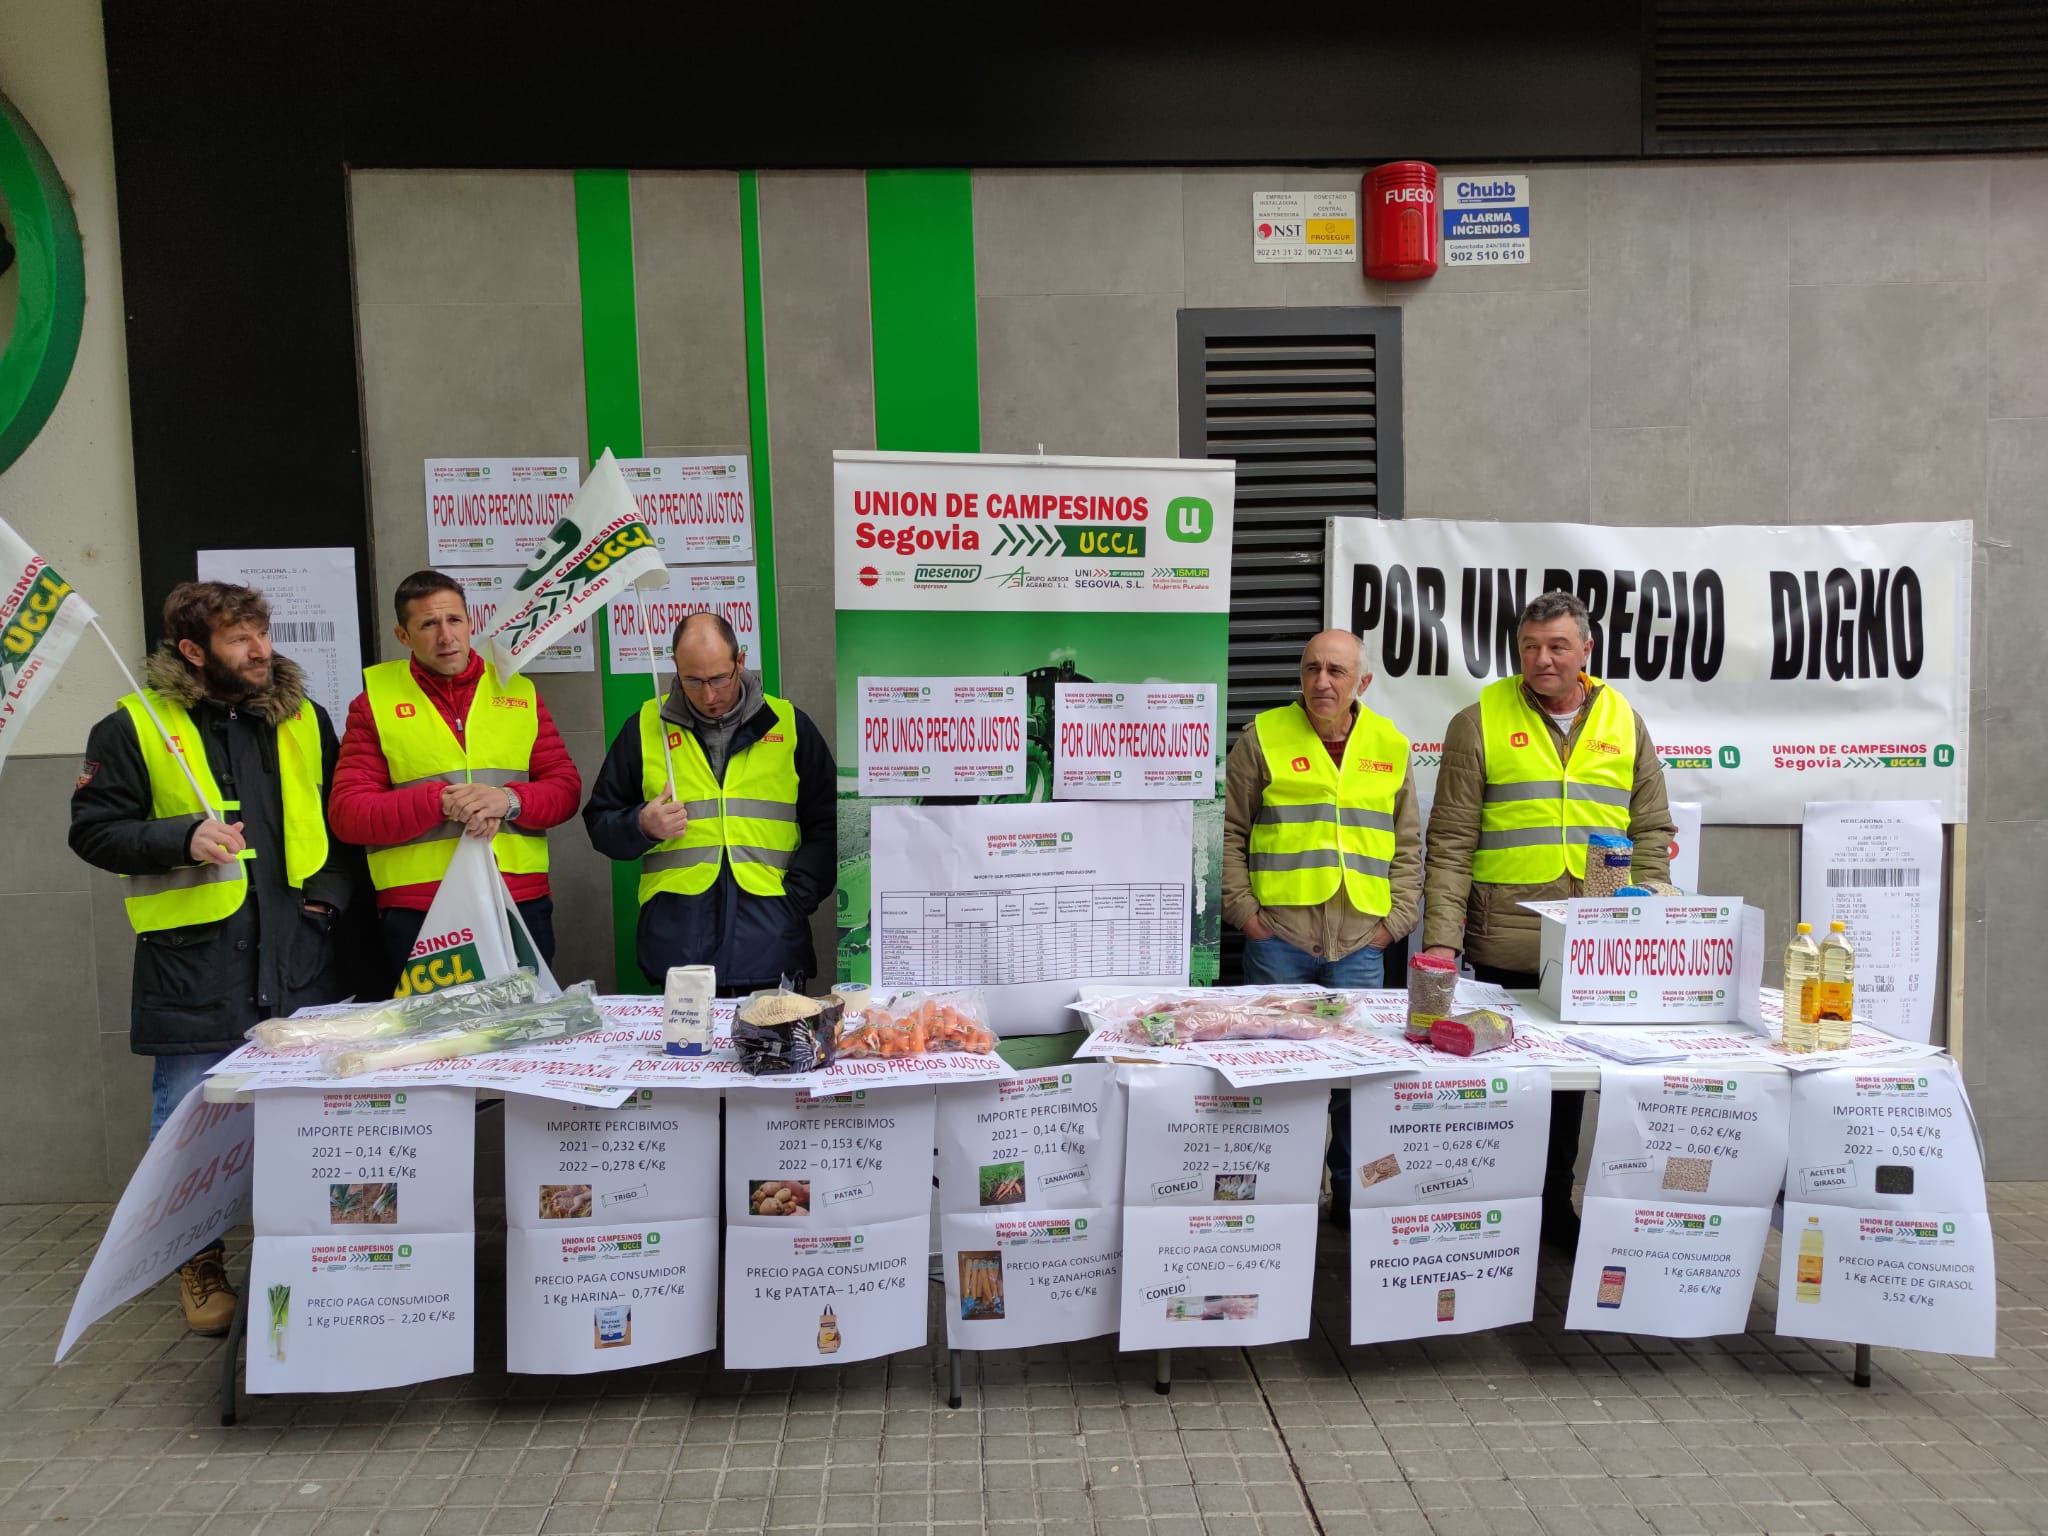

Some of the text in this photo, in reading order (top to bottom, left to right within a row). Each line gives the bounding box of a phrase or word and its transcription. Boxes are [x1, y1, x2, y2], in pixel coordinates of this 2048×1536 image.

[1386, 188, 1434, 204] FUEGO
[1457, 182, 1515, 197] Chubb
[1461, 212, 1512, 223] ALARMA
[1274, 225, 1302, 237] NST
[1452, 224, 1520, 235] INCENDIOS
[1451, 250, 1525, 261] 902 510 610
[433, 493, 532, 527] POR UNOS PRECIOS
[854, 490, 1149, 521] UNION DE CAMPESINOS
[855, 522, 1138, 555] Segovia UCCL
[585, 526, 655, 571] UCCL
[490, 512, 644, 638] UNION DE CAMPESINOS
[919, 567, 976, 578] mesenor
[1176, 568, 1209, 577] ISMUR
[1075, 580, 1123, 590] SEGOVIA,
[1126, 580, 1145, 588] S.L.
[3, 577, 71, 655] UCCL
[511, 576, 609, 656] Castilla y León
[1351, 563, 1450, 679] POR
[1461, 567, 1529, 681] UN
[1769, 565, 1924, 681] DIGNO
[8, 658, 42, 699] León
[865, 716, 1020, 753] POR UNOS PRECIOS JUSTOS
[1773, 744, 1927, 754] UNION DE CAMPESINOS
[1677, 760, 1708, 768] UCCL
[1774, 757, 1922, 771] Segovia UCCL
[1570, 938, 1733, 976] POR UNOS PRECIOS JUSTOS
[848, 1057, 1000, 1075] UNOS PRECIOS JUSTOS
[1394, 1079, 1487, 1090] UNION DE CAMPESINOS
[1394, 1090, 1485, 1102] Segovia UCCL
[1638, 1102, 1758, 1122] IMPORTE PERCIBIMOS
[297, 1124, 433, 1138] IMPORTE PERCIBIMOS
[1847, 1125, 1941, 1139] 2021 0,54 €/Kg
[312, 1145, 417, 1159] 2021 0,14 €/Kg
[1403, 1138, 1500, 1152] 2021 0,628 €/Kg
[1645, 1140, 1738, 1159] 2022 0,60 €/Kg
[559, 1159, 666, 1172] 2022 0,278 €/Kg
[779, 1157, 882, 1170] 2022 0,171 €/Kg
[1183, 1160, 1270, 1173] 2022 2,15€/Kg
[1609, 1161, 1648, 1171] GARBANZO
[1045, 1170, 1085, 1185] ZANAHORIA
[1810, 1168, 1835, 1177] ACEITE
[1158, 1180, 1199, 1195] CONEJO
[1421, 1177, 1469, 1194] LENTEJAS
[1813, 1178, 1846, 1187] GIRASOL
[614, 1191, 637, 1202] TRIGO
[834, 1189, 863, 1200] PATATA
[1164, 1259, 1281, 1274] 1 Kg CONEJO 6,49 €/Kg
[1664, 1267, 1741, 1278] 1 Kg GARBANZOS
[535, 1265, 686, 1286] PRECIO PAGA CONSUMIDOR
[1029, 1267, 1117, 1287] 1 Kg ZANAHORIAS
[1845, 1271, 1973, 1290] 1 Kg ACEITE DE GIRASOL
[755, 1287, 761, 1299] 1
[766, 1287, 781, 1300] Kg
[848, 1281, 875, 1296] 1,40
[878, 1276, 906, 1290] €/Kg
[1051, 1286, 1097, 1301] 0,76 €/Kg
[1679, 1284, 1721, 1295] 2,86 €/Kg
[1882, 1291, 1934, 1307] 3,52 €/Kg
[307, 1310, 455, 1328] 1 Kg PUERROS 2,20 €/Kg
